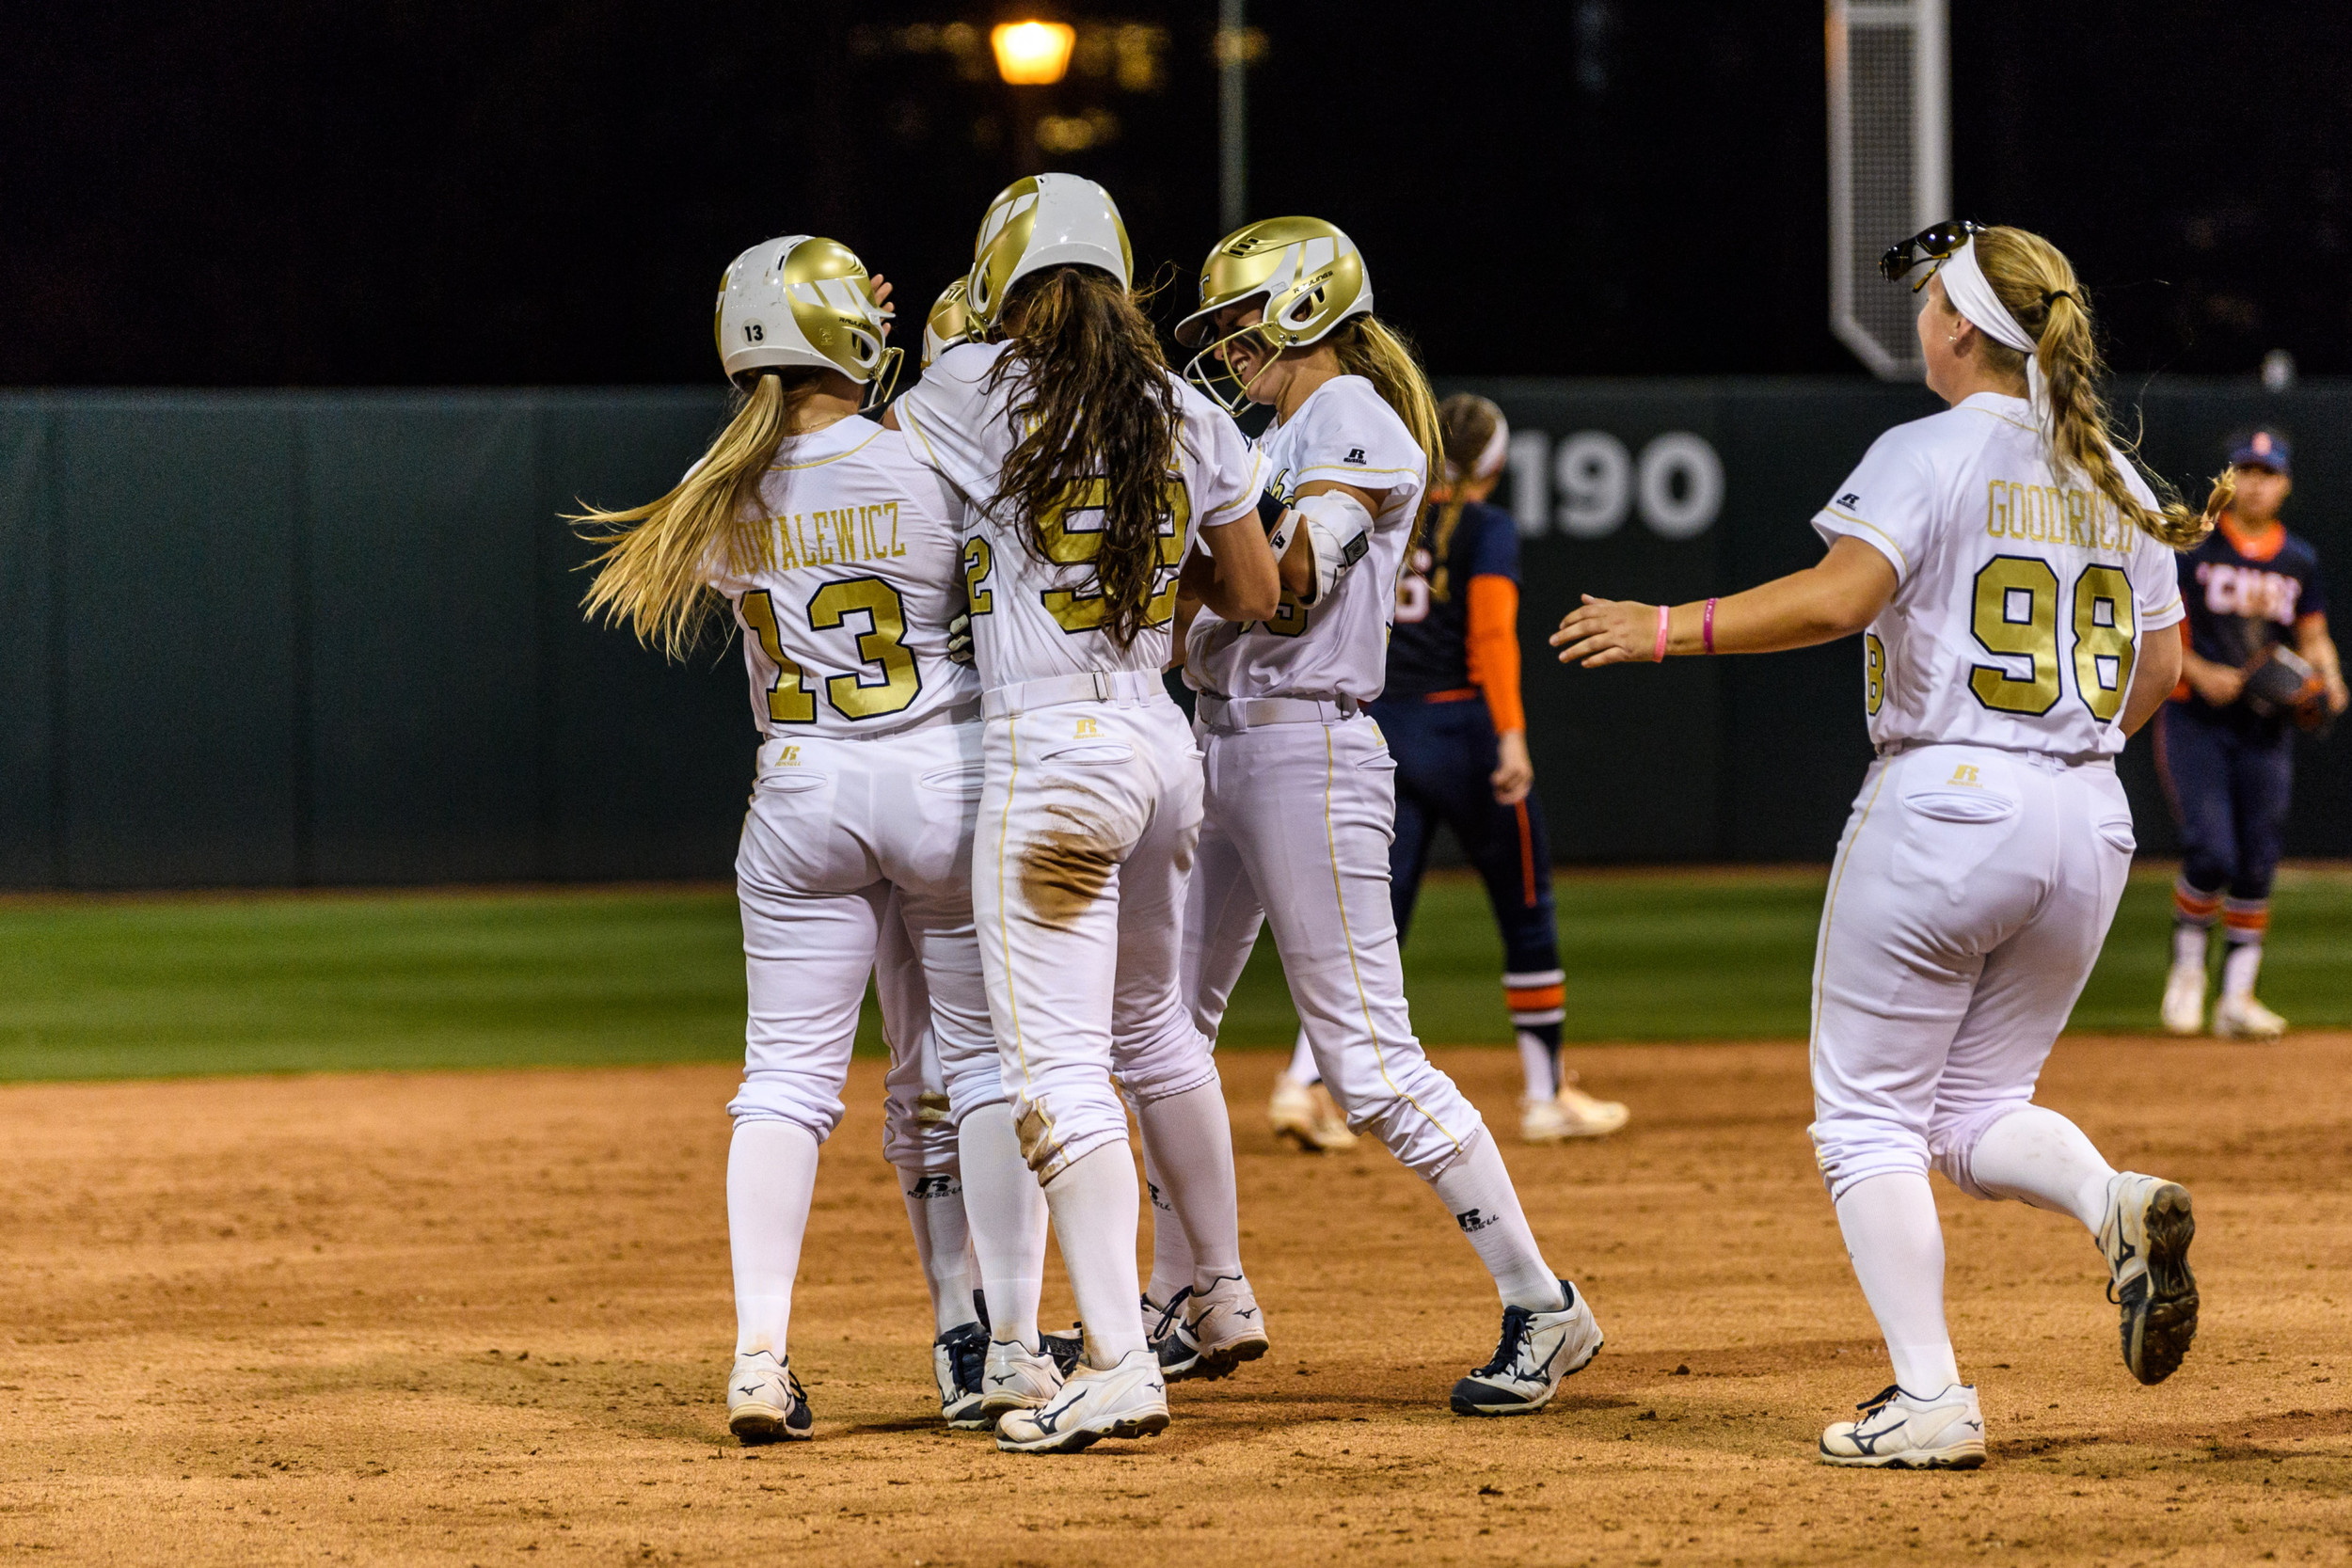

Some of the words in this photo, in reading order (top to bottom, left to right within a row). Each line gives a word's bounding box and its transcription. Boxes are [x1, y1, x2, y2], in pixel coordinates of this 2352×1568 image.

[744, 325, 764, 342] 13
[1507, 430, 1725, 540] 190
[1987, 480, 2134, 552] GOODRICH
[739, 576, 923, 724] 13
[1968, 554, 2136, 723] 98
